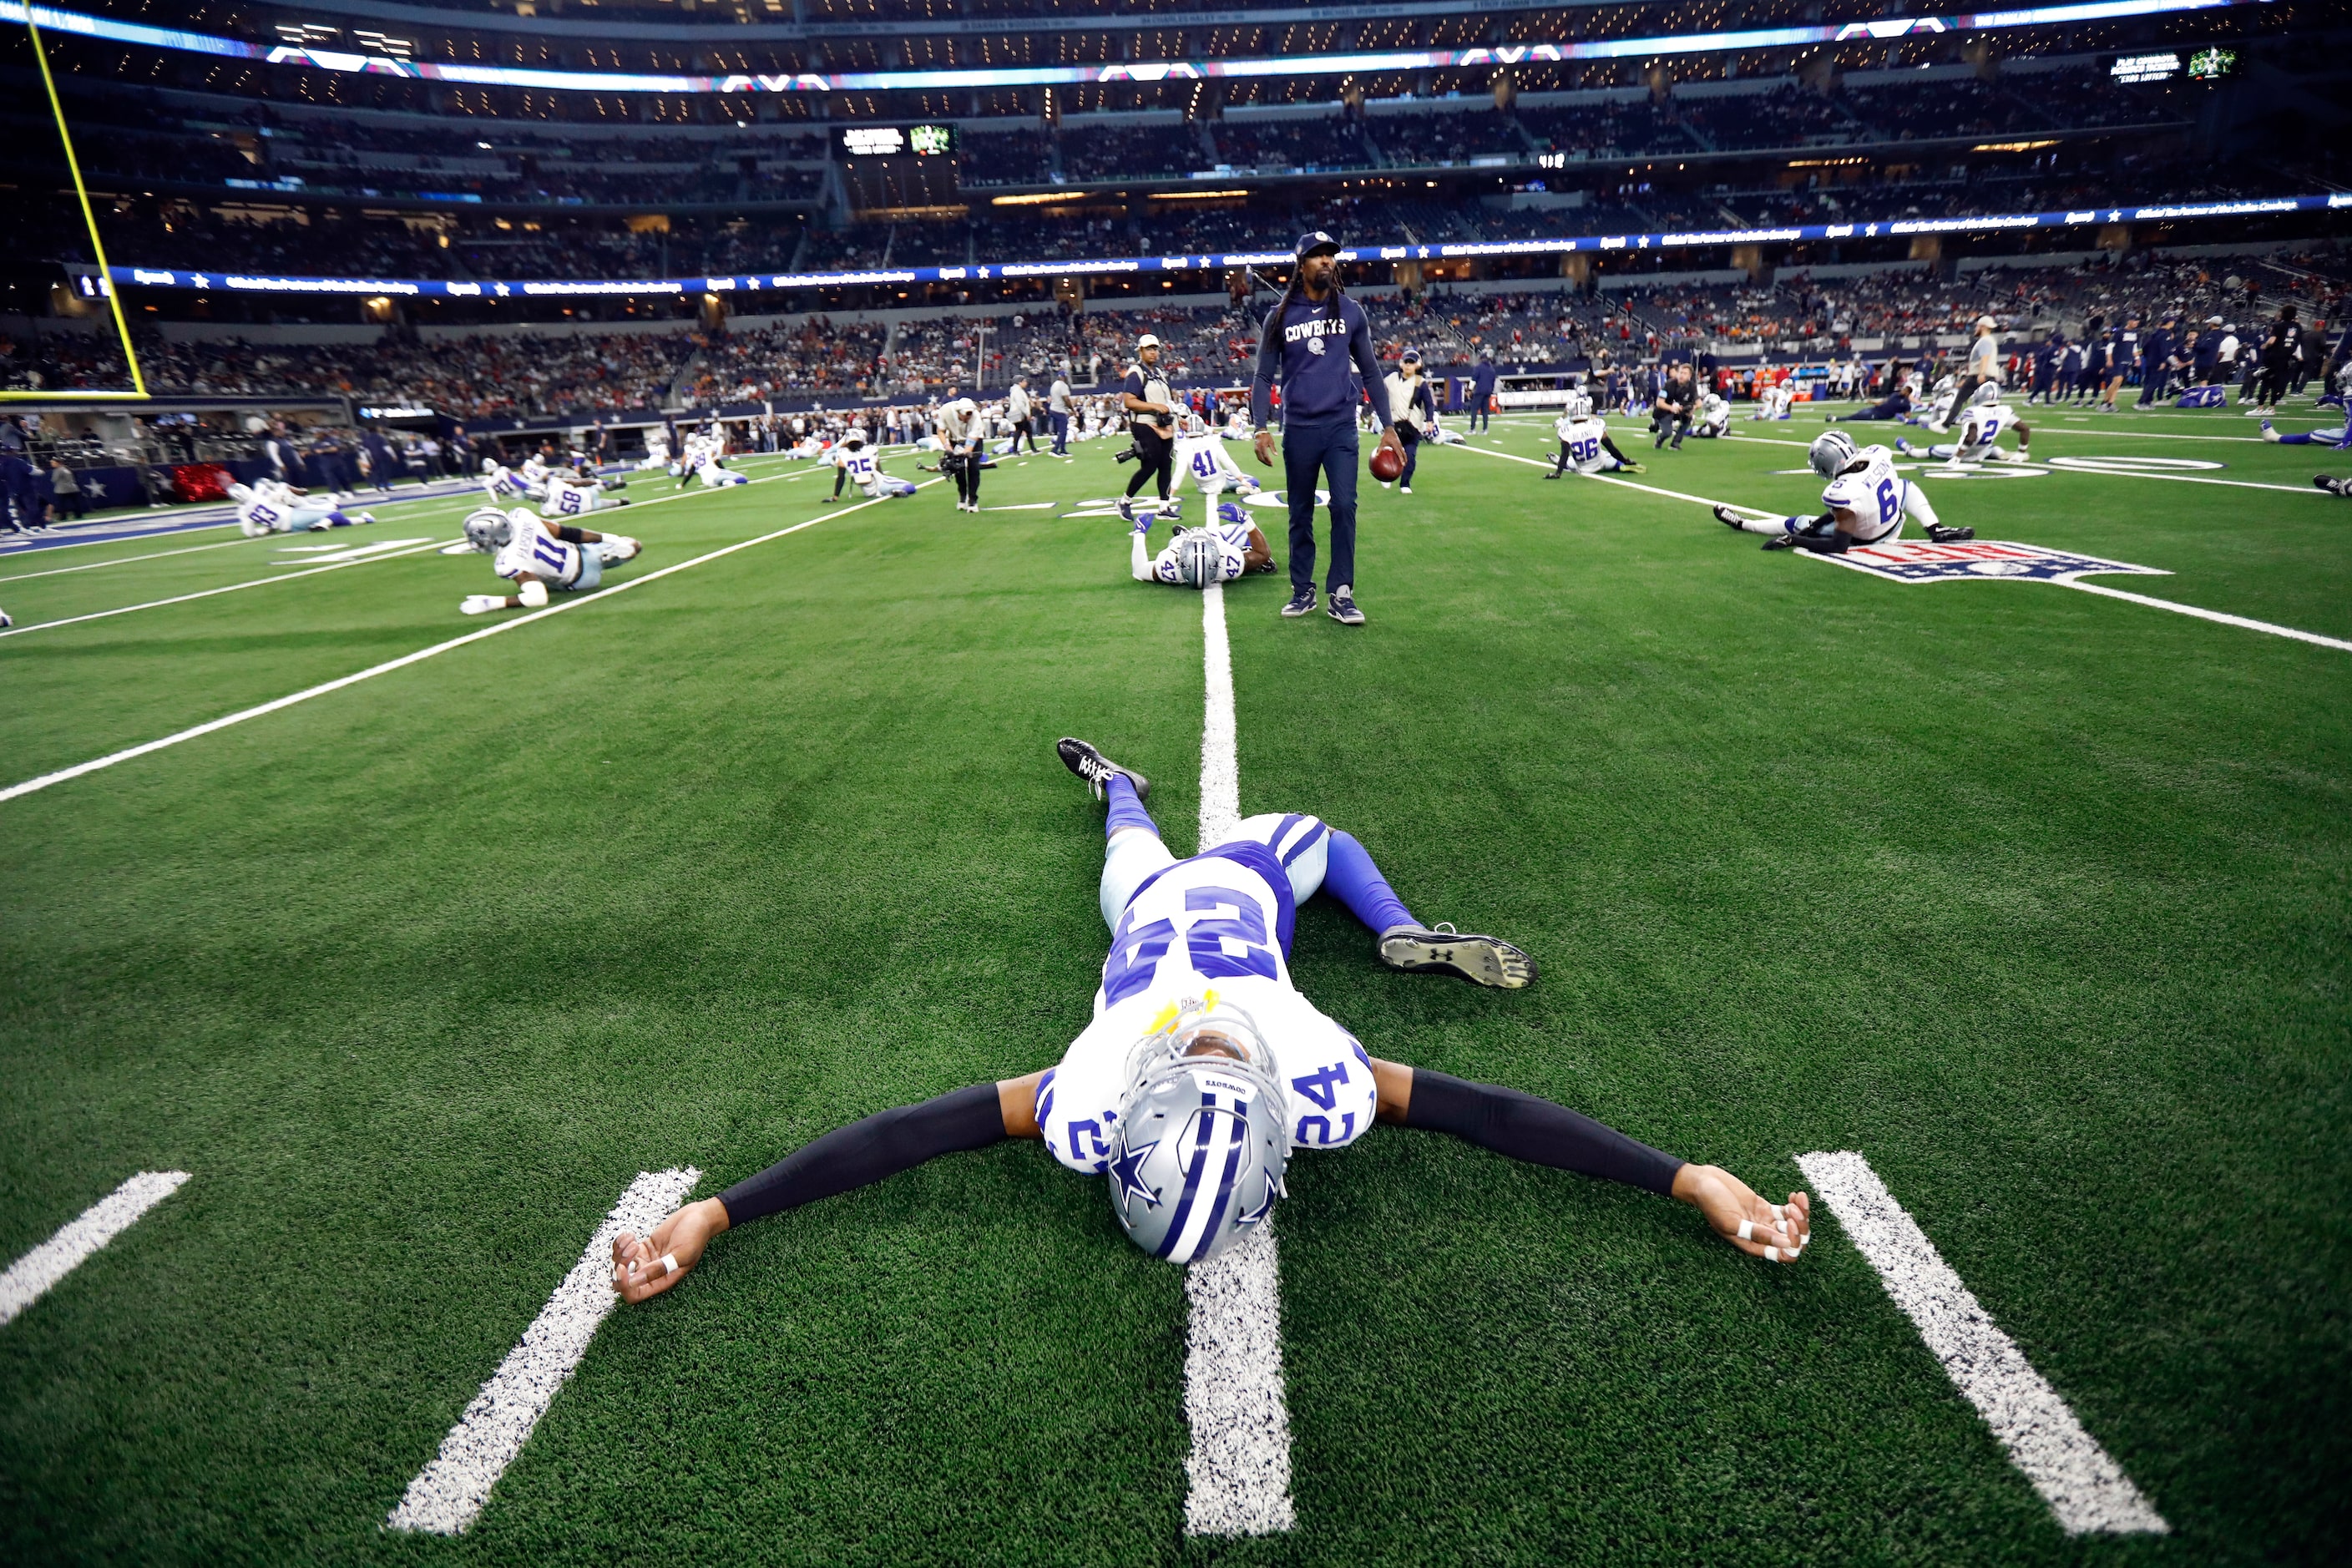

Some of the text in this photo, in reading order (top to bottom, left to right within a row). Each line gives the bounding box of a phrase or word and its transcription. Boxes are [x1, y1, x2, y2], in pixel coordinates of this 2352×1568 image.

[1976, 419, 1999, 445] 2
[1571, 437, 1598, 462] 26
[1192, 449, 1217, 478] 41
[1861, 459, 1890, 490] WILSON
[559, 489, 582, 514] 58
[1876, 478, 1898, 525] 6
[248, 503, 280, 529] 93
[533, 534, 568, 574] 11
[1226, 555, 1241, 579] 47
[1161, 559, 1177, 582] 47
[1103, 885, 1278, 1012] 24
[1205, 1079, 1247, 1095] COWBOYS
[1291, 1061, 1356, 1146] 24
[1068, 1110, 1119, 1174] 2
